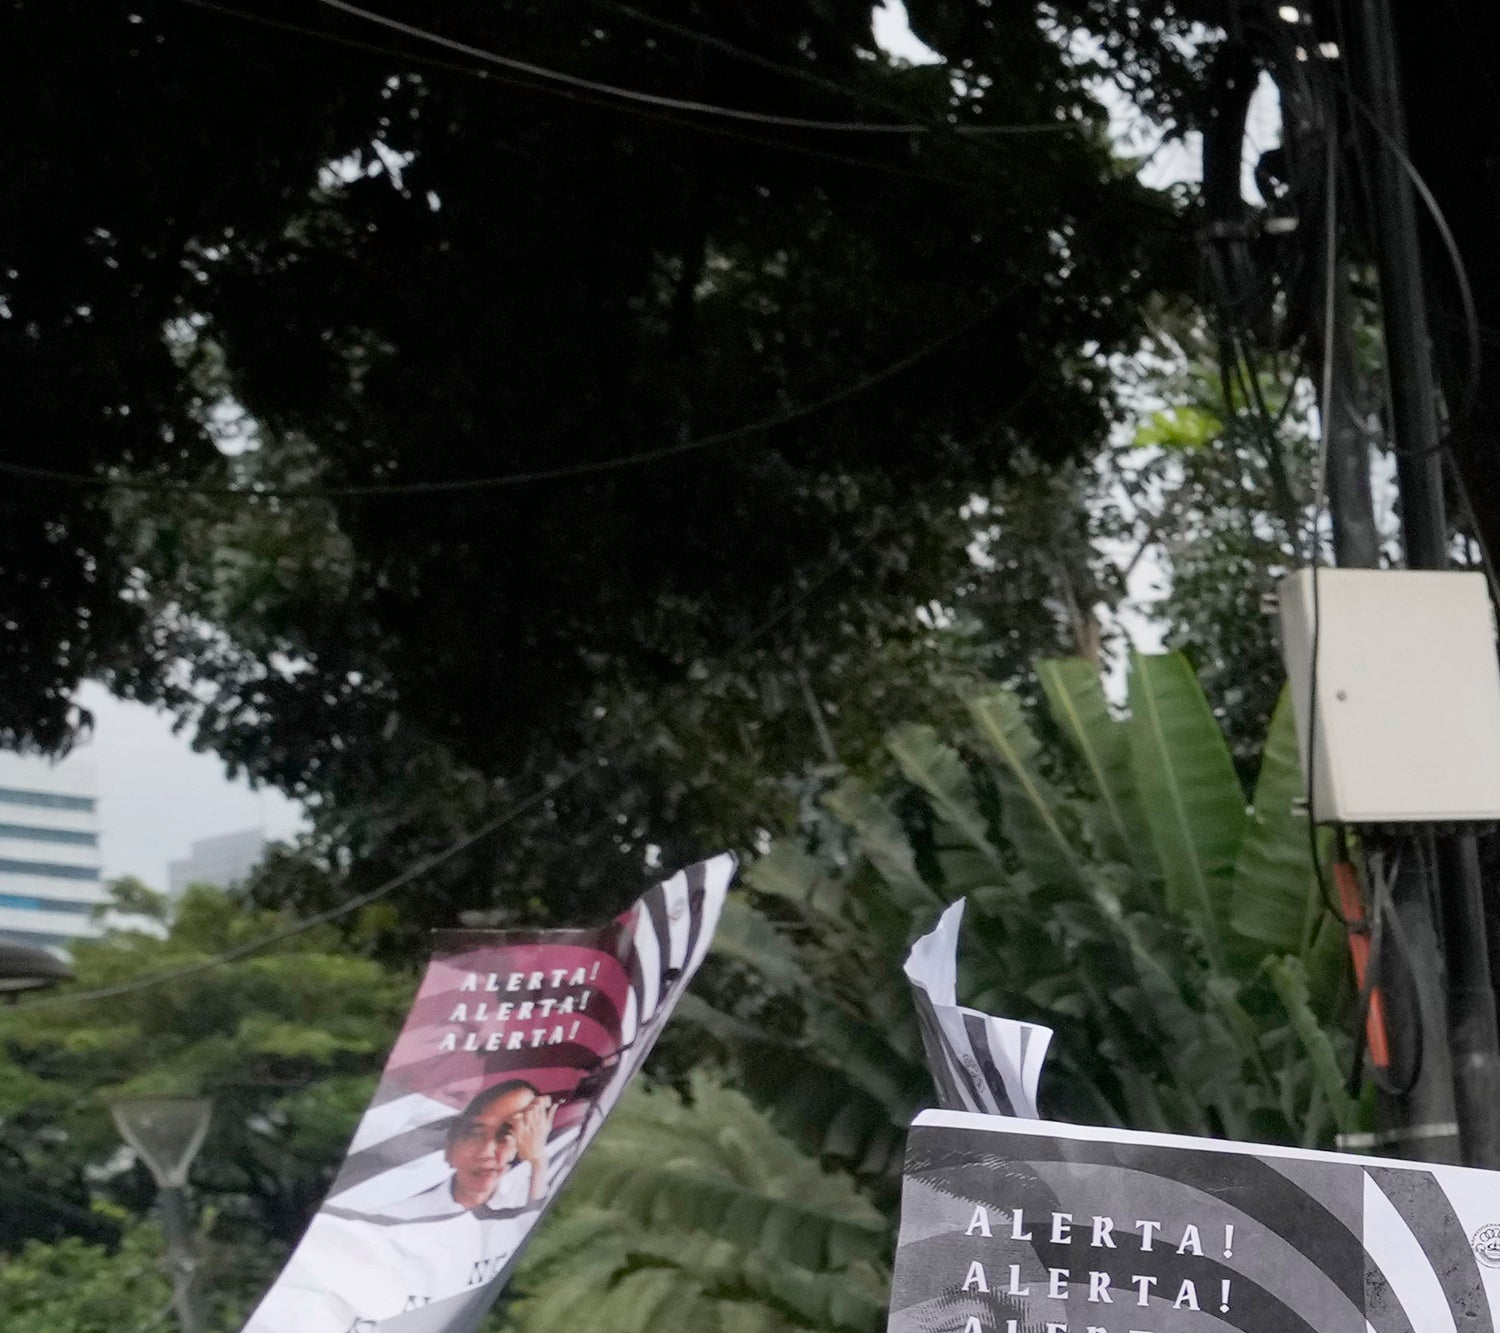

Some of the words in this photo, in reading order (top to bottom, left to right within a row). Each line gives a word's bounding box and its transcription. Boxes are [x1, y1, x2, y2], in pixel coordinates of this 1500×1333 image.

[460, 961, 600, 992] ALERTA!
[449, 990, 592, 1022] ALERTA!
[438, 1020, 581, 1051] ALERTA!
[965, 1206, 1236, 1260] ALERTA!
[960, 1261, 1234, 1314] ALERTA!
